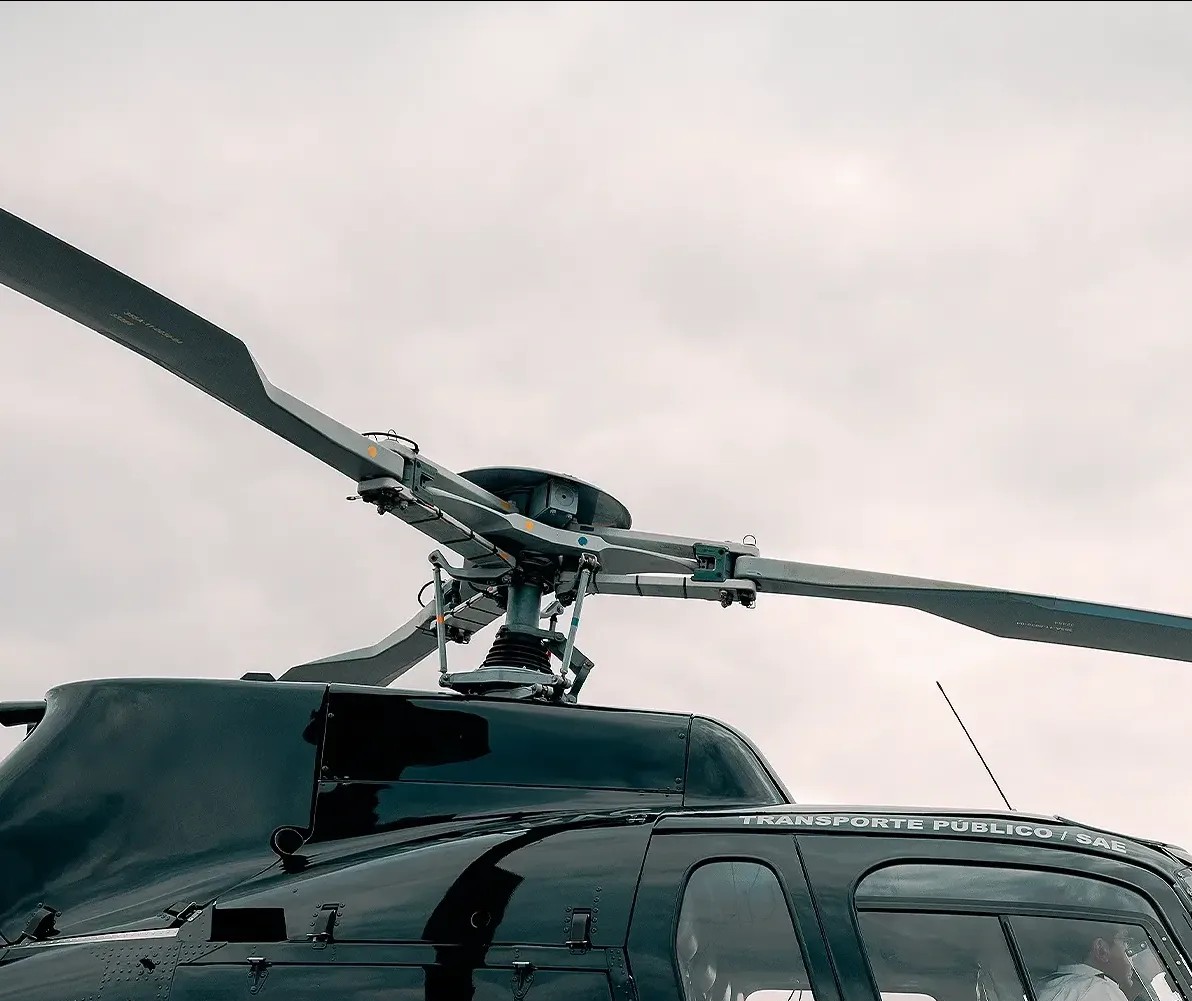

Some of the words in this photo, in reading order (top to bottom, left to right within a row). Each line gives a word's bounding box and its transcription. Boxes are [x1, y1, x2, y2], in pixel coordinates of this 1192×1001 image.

[738, 815, 924, 830] TRANSPORTE
[933, 819, 1053, 839] PÚBLICO
[1060, 830, 1068, 841] /
[1076, 832, 1127, 854] SAE
